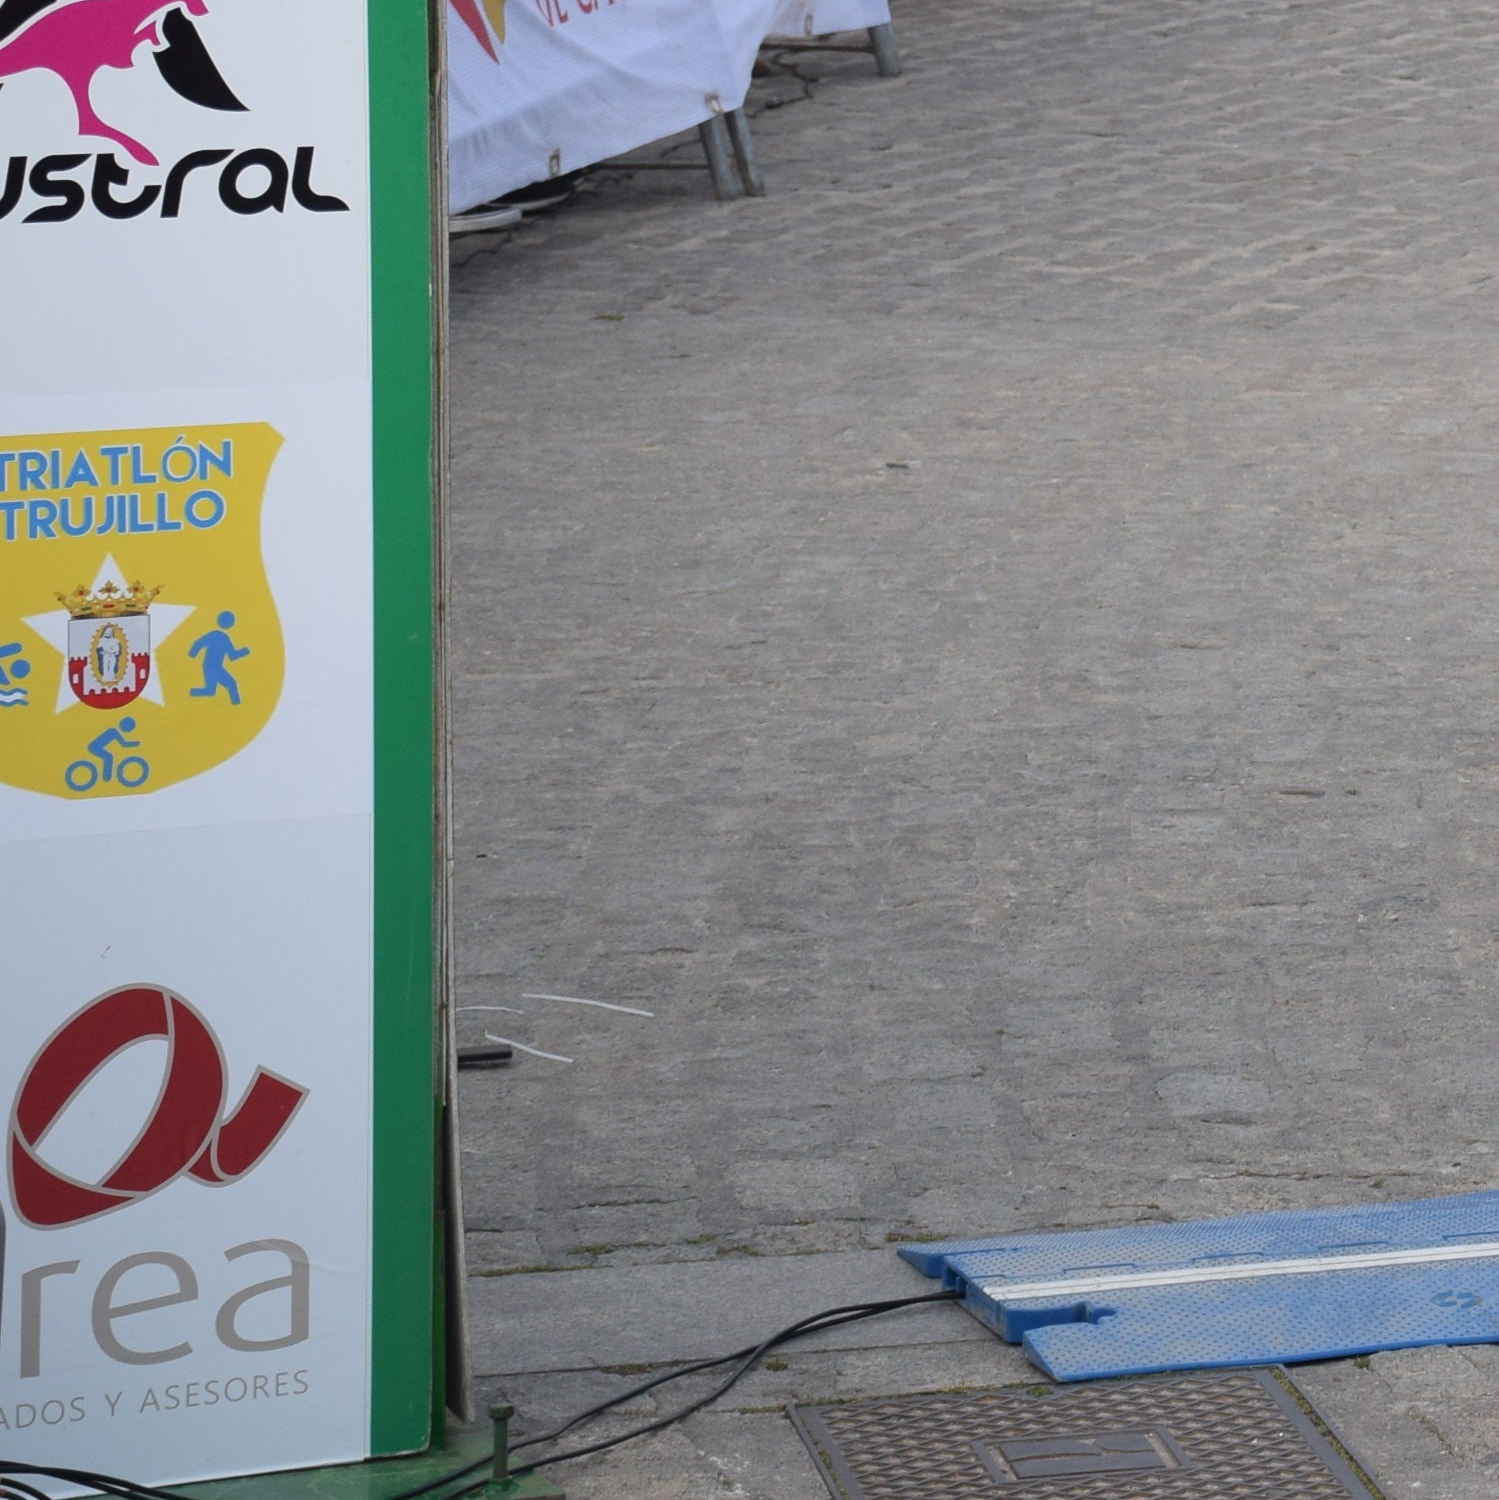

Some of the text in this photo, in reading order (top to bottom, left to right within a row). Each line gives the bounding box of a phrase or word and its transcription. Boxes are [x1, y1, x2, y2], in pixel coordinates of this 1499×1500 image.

[0, 489, 227, 541] TRUJILLO
[105, 1391, 123, 1417] Y
[139, 1369, 310, 1414] ASESORES
